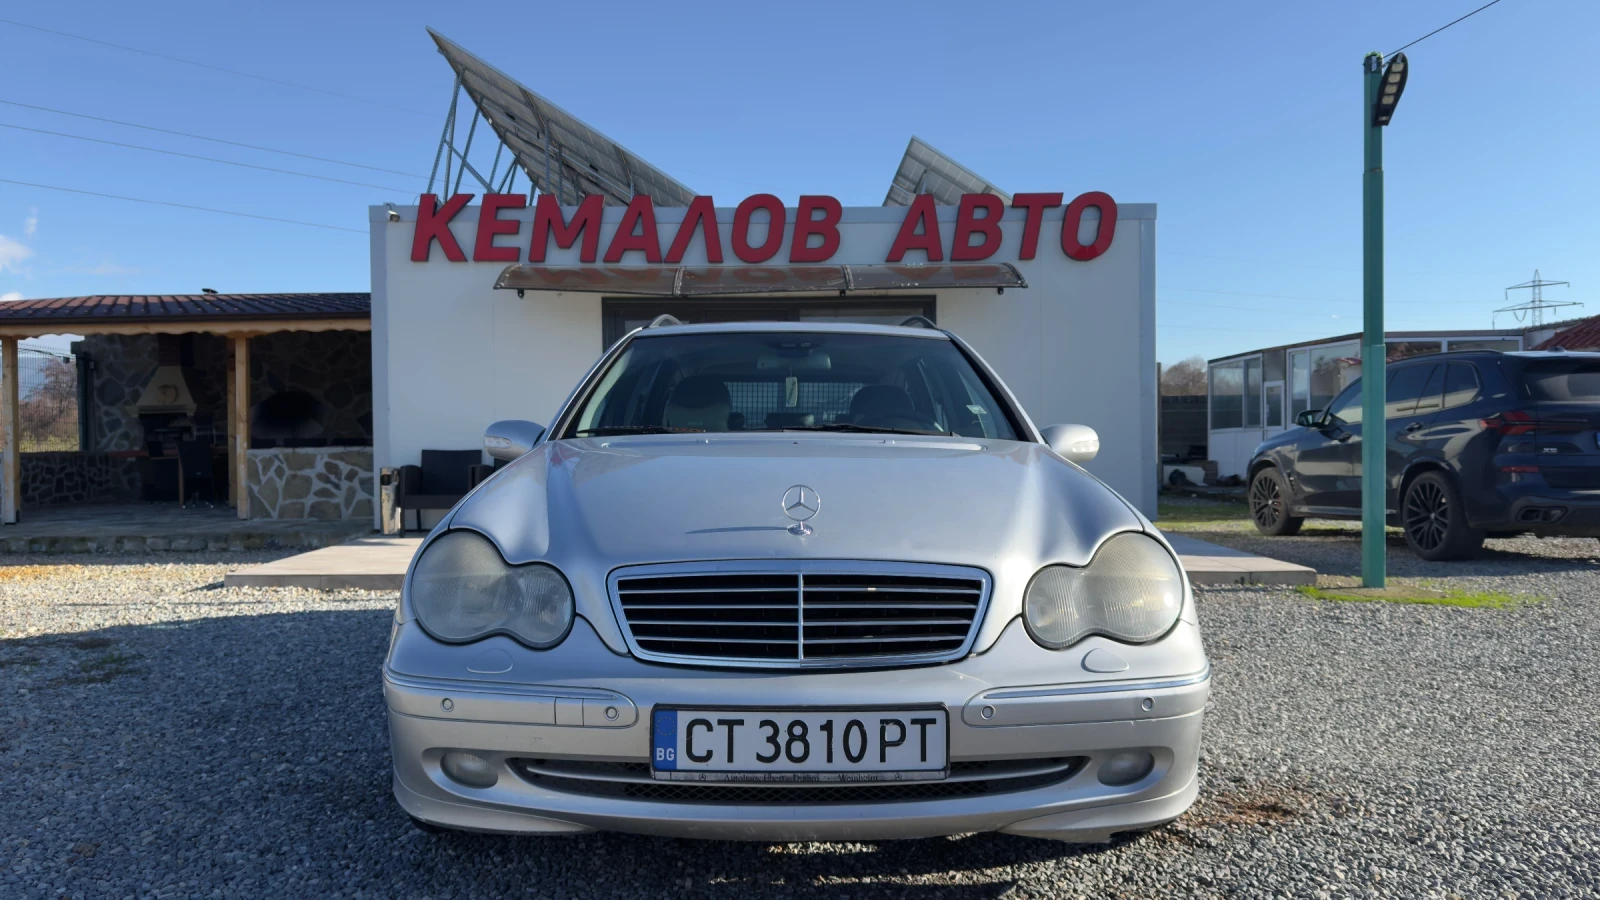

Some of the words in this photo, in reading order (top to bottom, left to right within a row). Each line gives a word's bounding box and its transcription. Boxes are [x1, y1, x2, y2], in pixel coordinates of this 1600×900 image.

[410, 193, 843, 263] КЕМАЛОВ
[885, 191, 1118, 262] АВТО
[656, 747, 675, 761] BG
[685, 718, 744, 763] CT
[756, 719, 868, 763] 3810
[879, 718, 937, 763] PT
